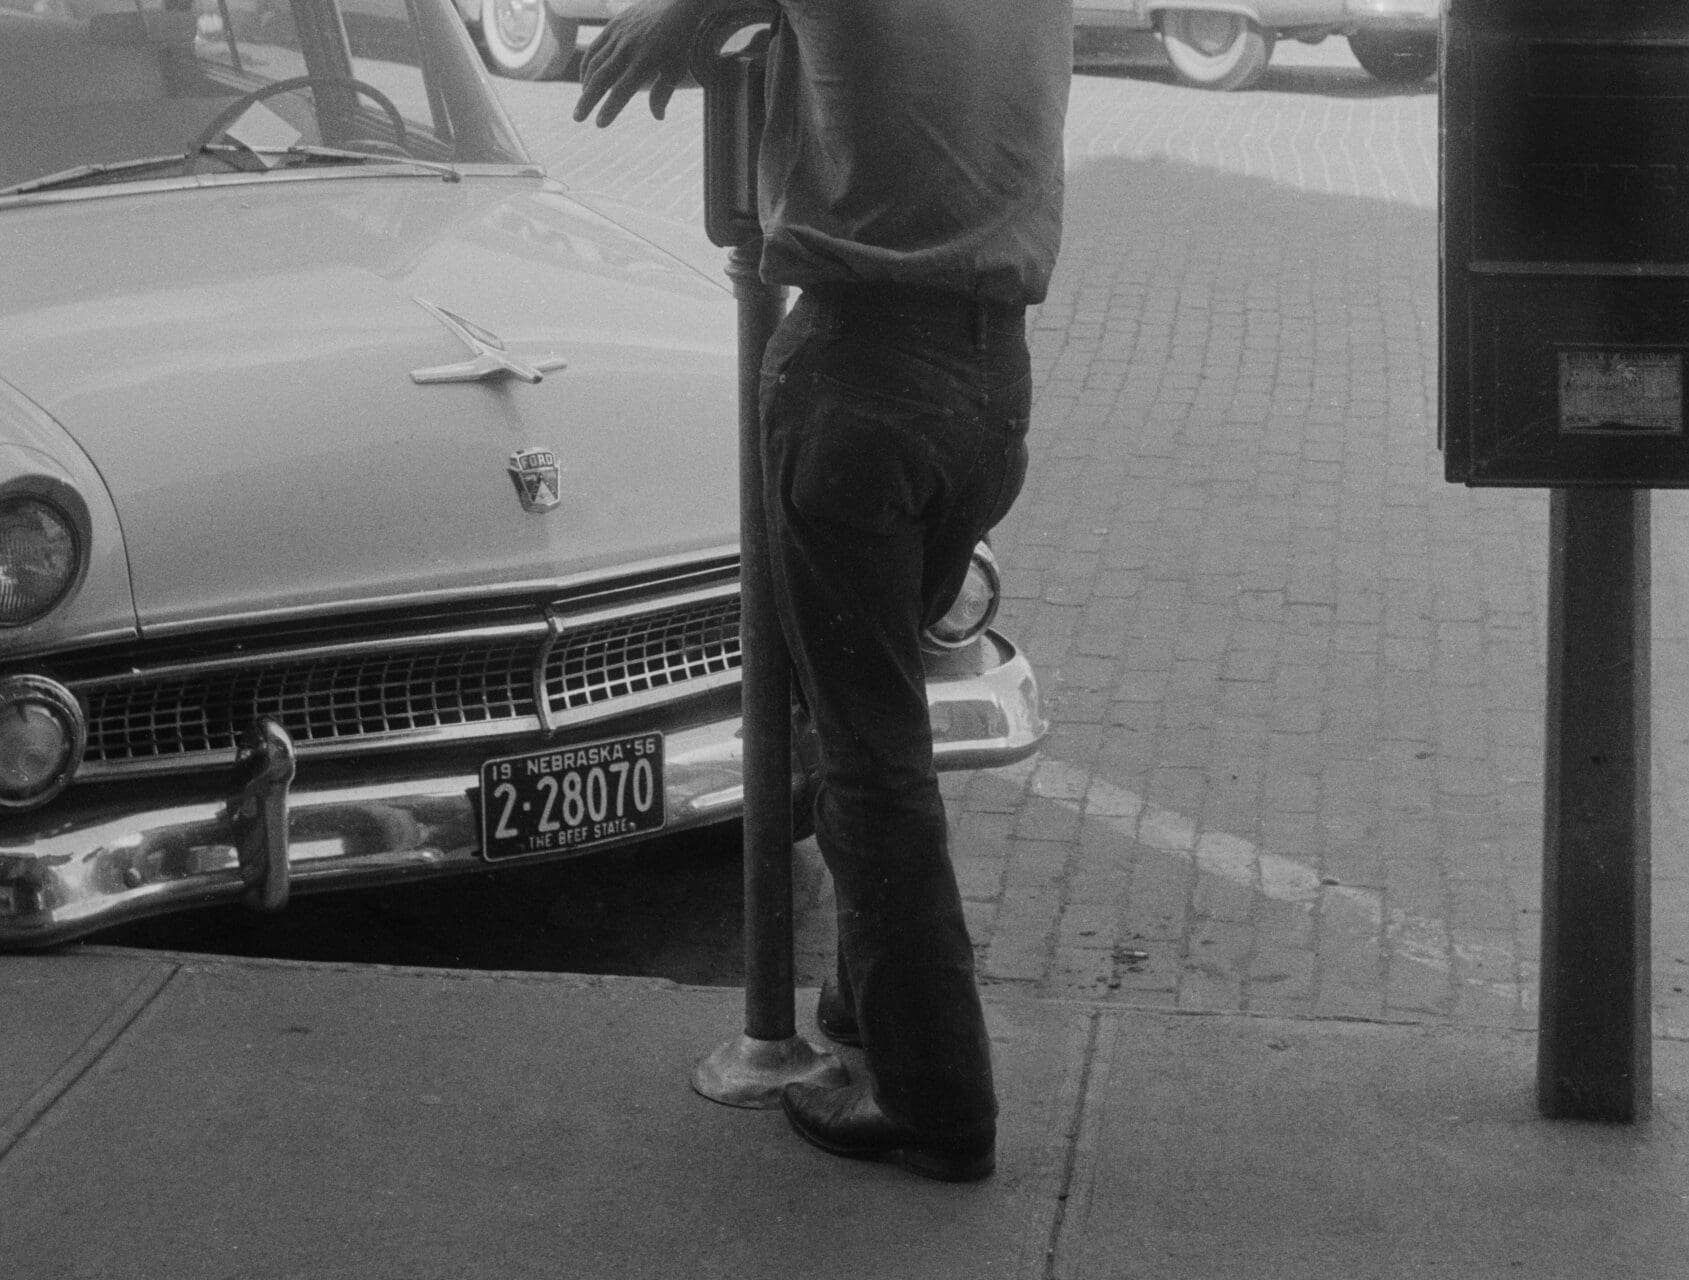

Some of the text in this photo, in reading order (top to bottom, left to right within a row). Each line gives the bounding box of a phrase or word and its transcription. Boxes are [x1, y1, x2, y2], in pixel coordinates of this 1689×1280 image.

[520, 453, 553, 469] FORD
[492, 763, 512, 781] 19
[527, 744, 623, 775] NEBRASKA
[529, 818, 628, 849] THE BEEF STATE
